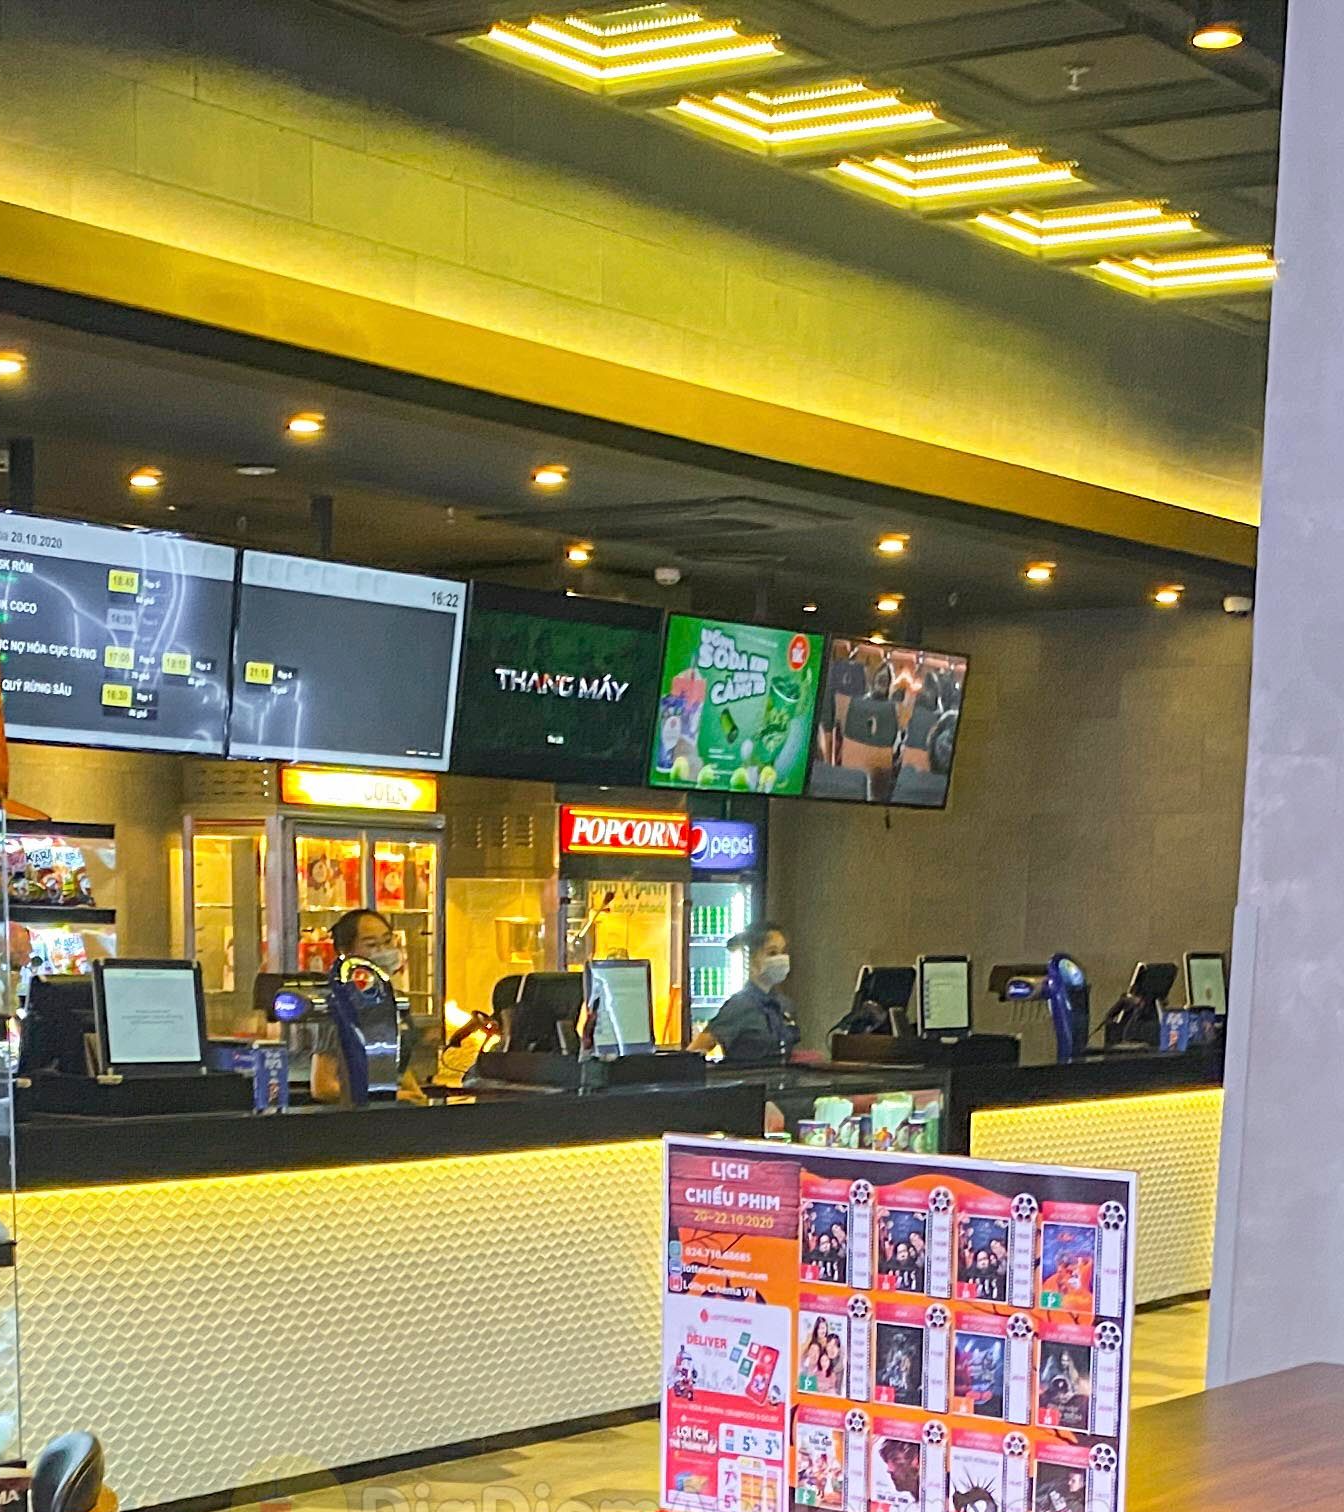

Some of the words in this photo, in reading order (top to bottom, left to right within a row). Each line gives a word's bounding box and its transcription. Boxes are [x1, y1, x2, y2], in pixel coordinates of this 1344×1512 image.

[11, 532, 63, 549] 20.10.2020
[431, 592, 458, 607] 16:22
[494, 668, 574, 697] THANG
[578, 673, 629, 701] MÁY
[571, 817, 683, 848] POPCORN
[710, 835, 753, 859] pepsi
[711, 1161, 749, 1180] LỊCH
[685, 1185, 734, 1206] CHIẾU
[739, 1193, 780, 1211] PHIM
[687, 1333, 727, 1349] DELIVER
